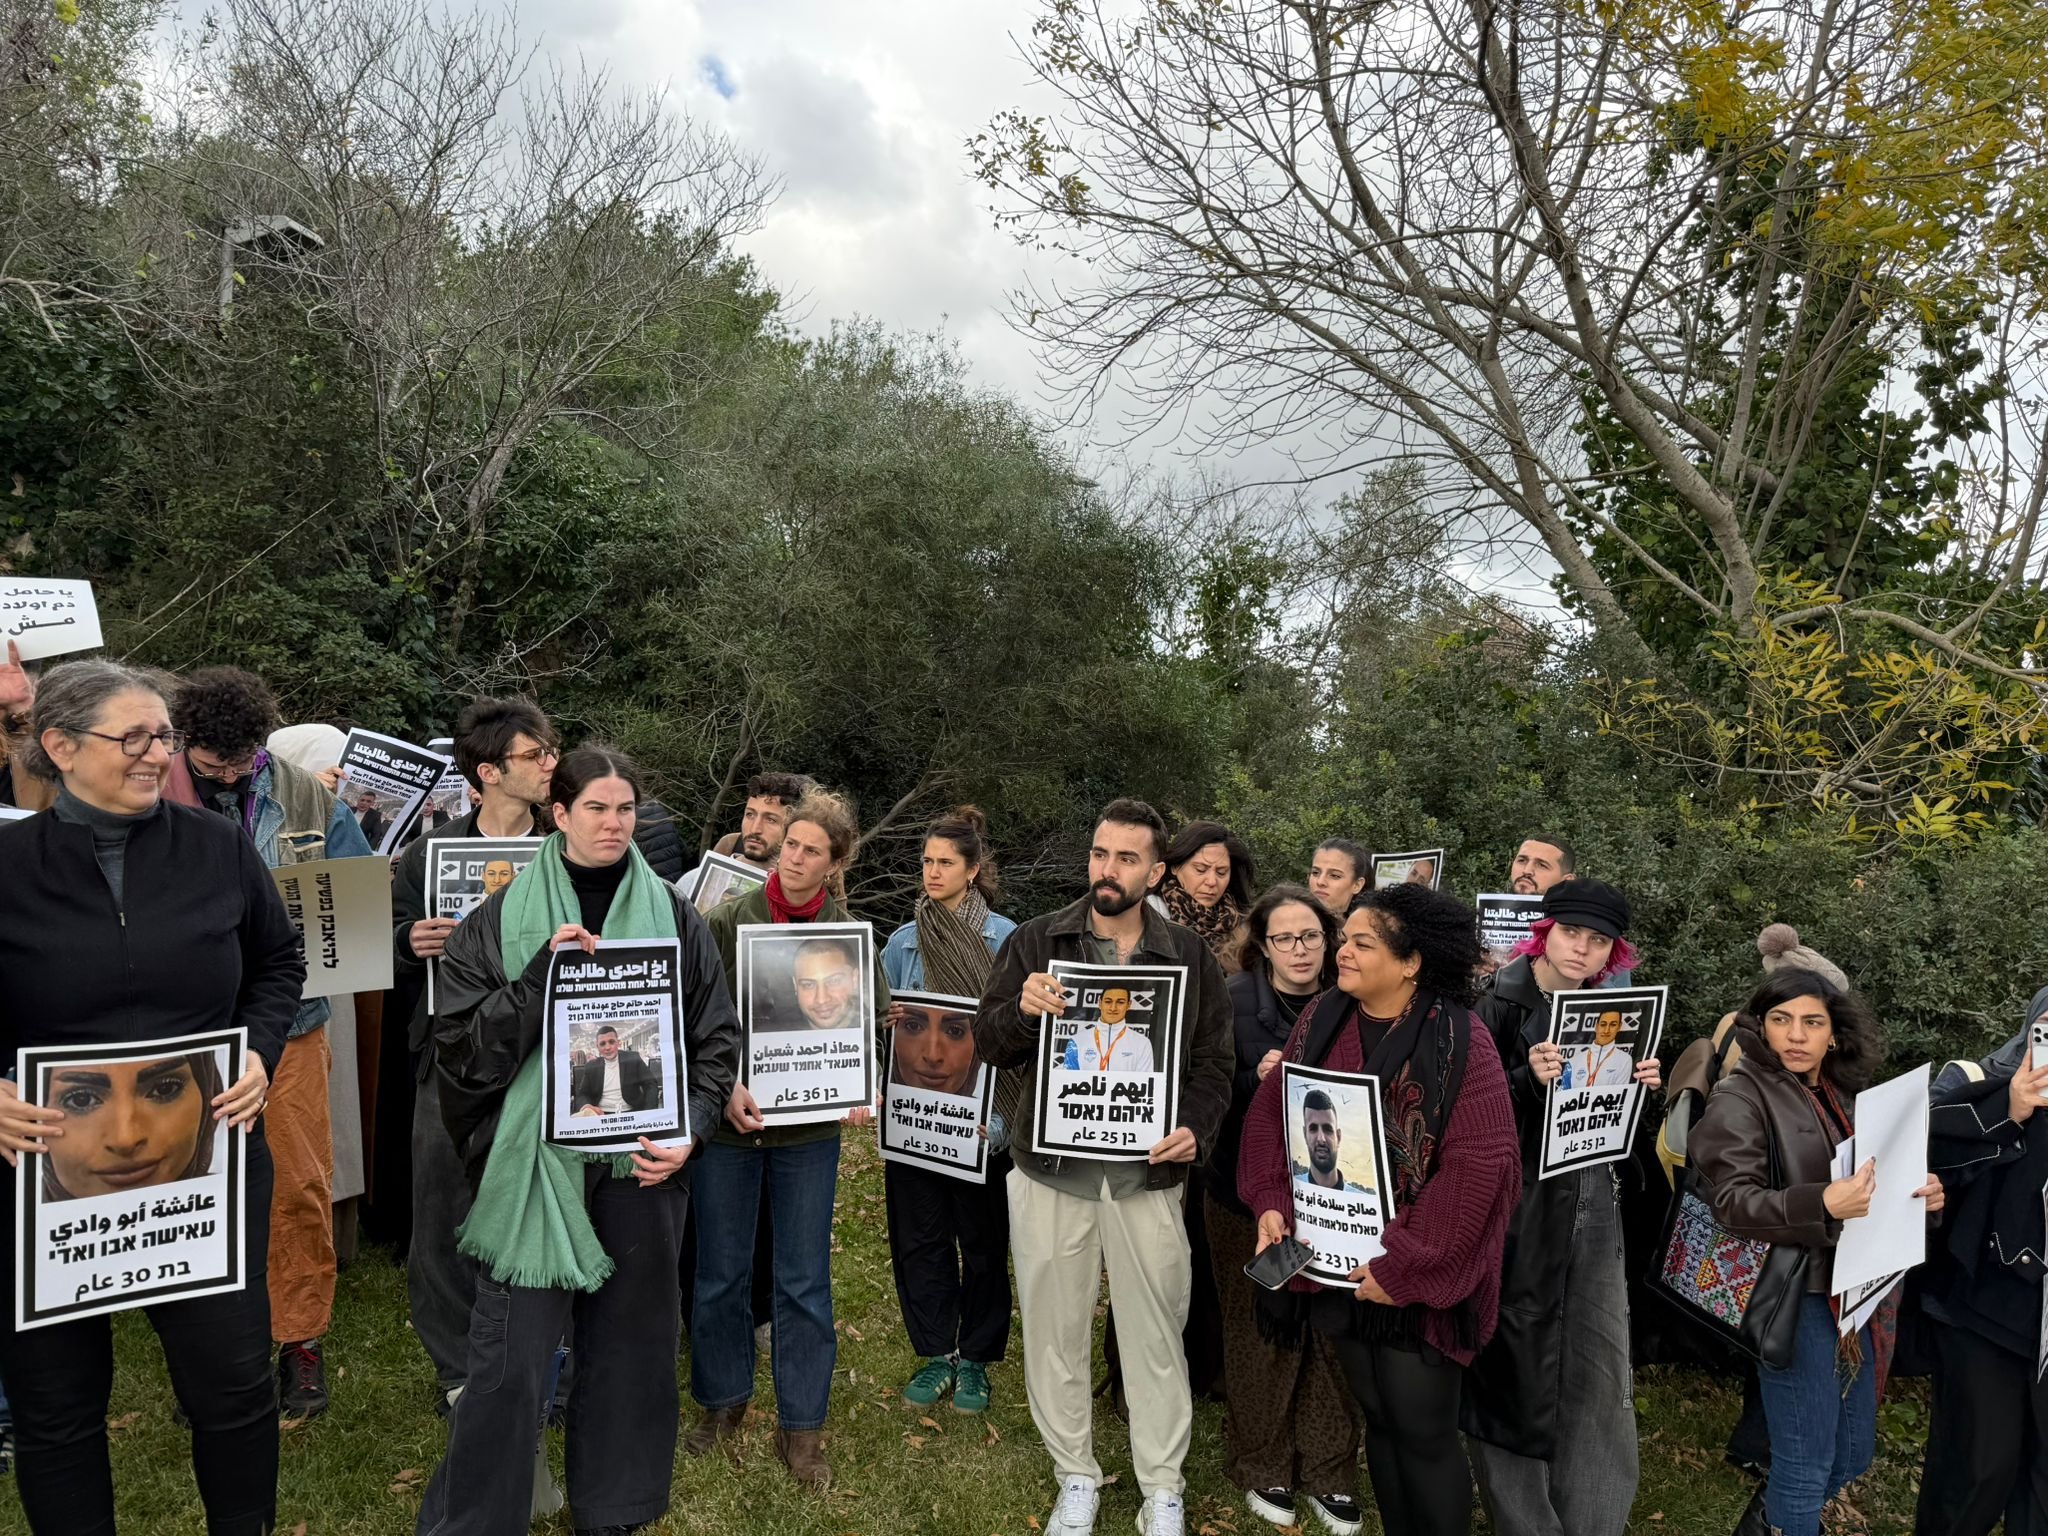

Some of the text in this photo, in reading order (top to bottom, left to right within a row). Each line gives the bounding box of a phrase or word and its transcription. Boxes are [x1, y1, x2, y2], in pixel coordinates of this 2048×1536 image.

[4, 588, 74, 598] يا حامل
[52, 602, 75, 611] دم
[288, 903, 304, 920] את
[315, 872, 340, 969] להיאבק בפשיעה
[556, 978, 671, 993] אח של אחת מהסטודנטיות שלנו
[567, 1003, 582, 1011] سنة
[592, 1002, 609, 1011] عودة
[611, 1001, 625, 1011] حاج
[626, 999, 643, 1009] حاتم
[644, 998, 661, 1006] احمد
[585, 1012, 602, 1020] עודה
[619, 1009, 639, 1018] חאתם
[640, 1008, 659, 1016] אחמד
[753, 1041, 860, 1061] معاذ احمد شعبان
[753, 1062, 790, 1076] שעבאן
[792, 1060, 822, 1072] אחמד
[1057, 1075, 1106, 1099] ناصر
[775, 1087, 839, 1107] בן 36 عام
[892, 1098, 975, 1120] عائشة أبو وادي
[1058, 1102, 1154, 1123] איהם נאסר
[1557, 1092, 1590, 1119] ناصر
[891, 1112, 974, 1138] עאישה אבו ואדי
[1556, 1111, 1622, 1137] איהם נאסר
[1072, 1127, 1137, 1145] בן 25 عام
[903, 1136, 958, 1158] בת 30 عام
[1563, 1136, 1606, 1159] בן 25 عام
[1306, 1192, 1316, 1207] أبو
[1317, 1194, 1345, 1212] سلامة
[1347, 1203, 1377, 1217] صالح
[50, 1193, 216, 1247] عائشة أبو وادي
[1306, 1214, 1317, 1226] אבו
[1319, 1217, 1349, 1232] סלאמה
[1350, 1223, 1378, 1236] סאלח
[48, 1219, 216, 1265] עאישה אבו ואדי
[1325, 1253, 1342, 1269] 23
[75, 1260, 191, 1301] בת 30 عام
